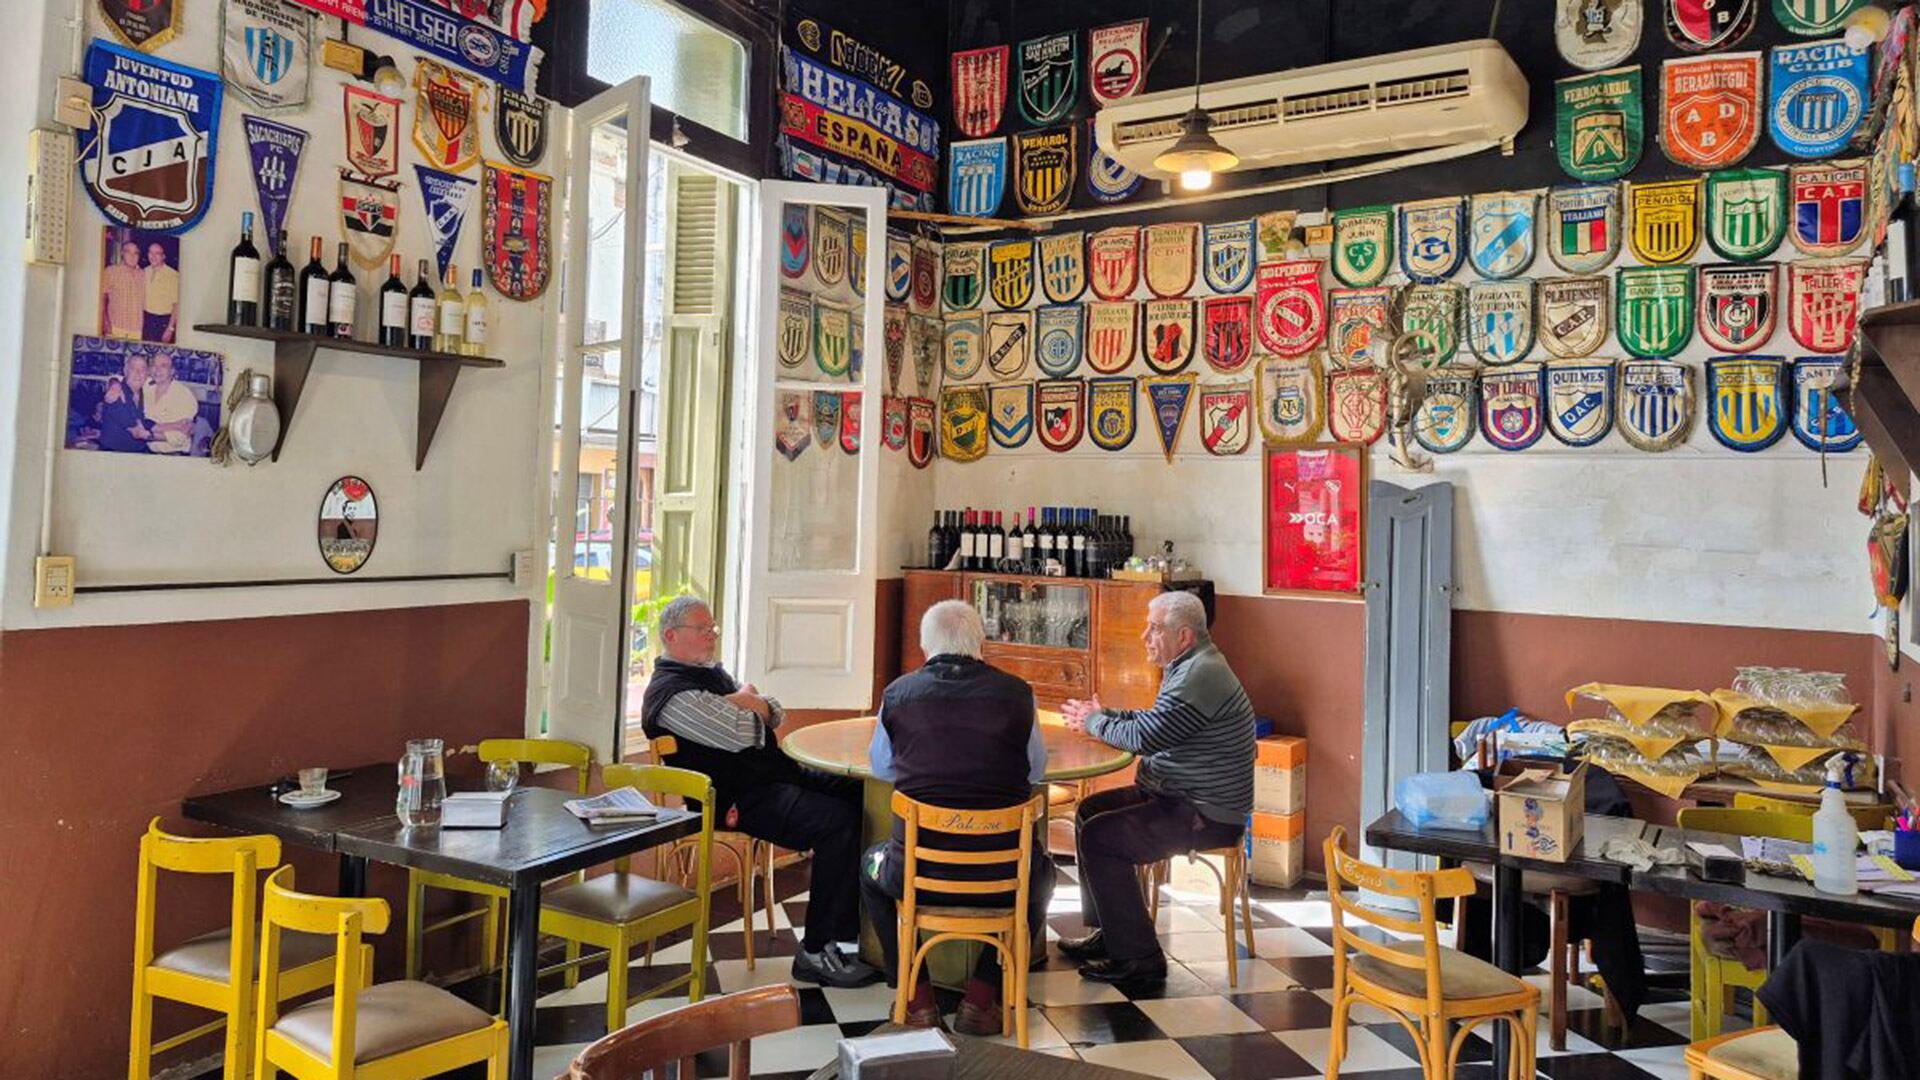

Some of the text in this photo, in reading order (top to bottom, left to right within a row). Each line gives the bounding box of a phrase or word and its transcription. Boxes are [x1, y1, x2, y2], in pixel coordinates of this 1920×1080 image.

[373, 0, 458, 48] CHELSEA
[114, 55, 193, 88] JUVENTUD
[1788, 58, 1854, 73] CLUB
[103, 70, 200, 112] ANTONIANA
[801, 60, 920, 147] HELLAS
[1686, 102, 1735, 124] A D
[816, 115, 903, 170] ESPAÑA
[111, 142, 186, 175] C J A
[1562, 208, 1605, 223] ITALIANO
[1348, 244, 1373, 257] C S
[1356, 254, 1366, 267] A
[1552, 371, 1605, 385] QUILMES
[1304, 512, 1339, 526] OCA
